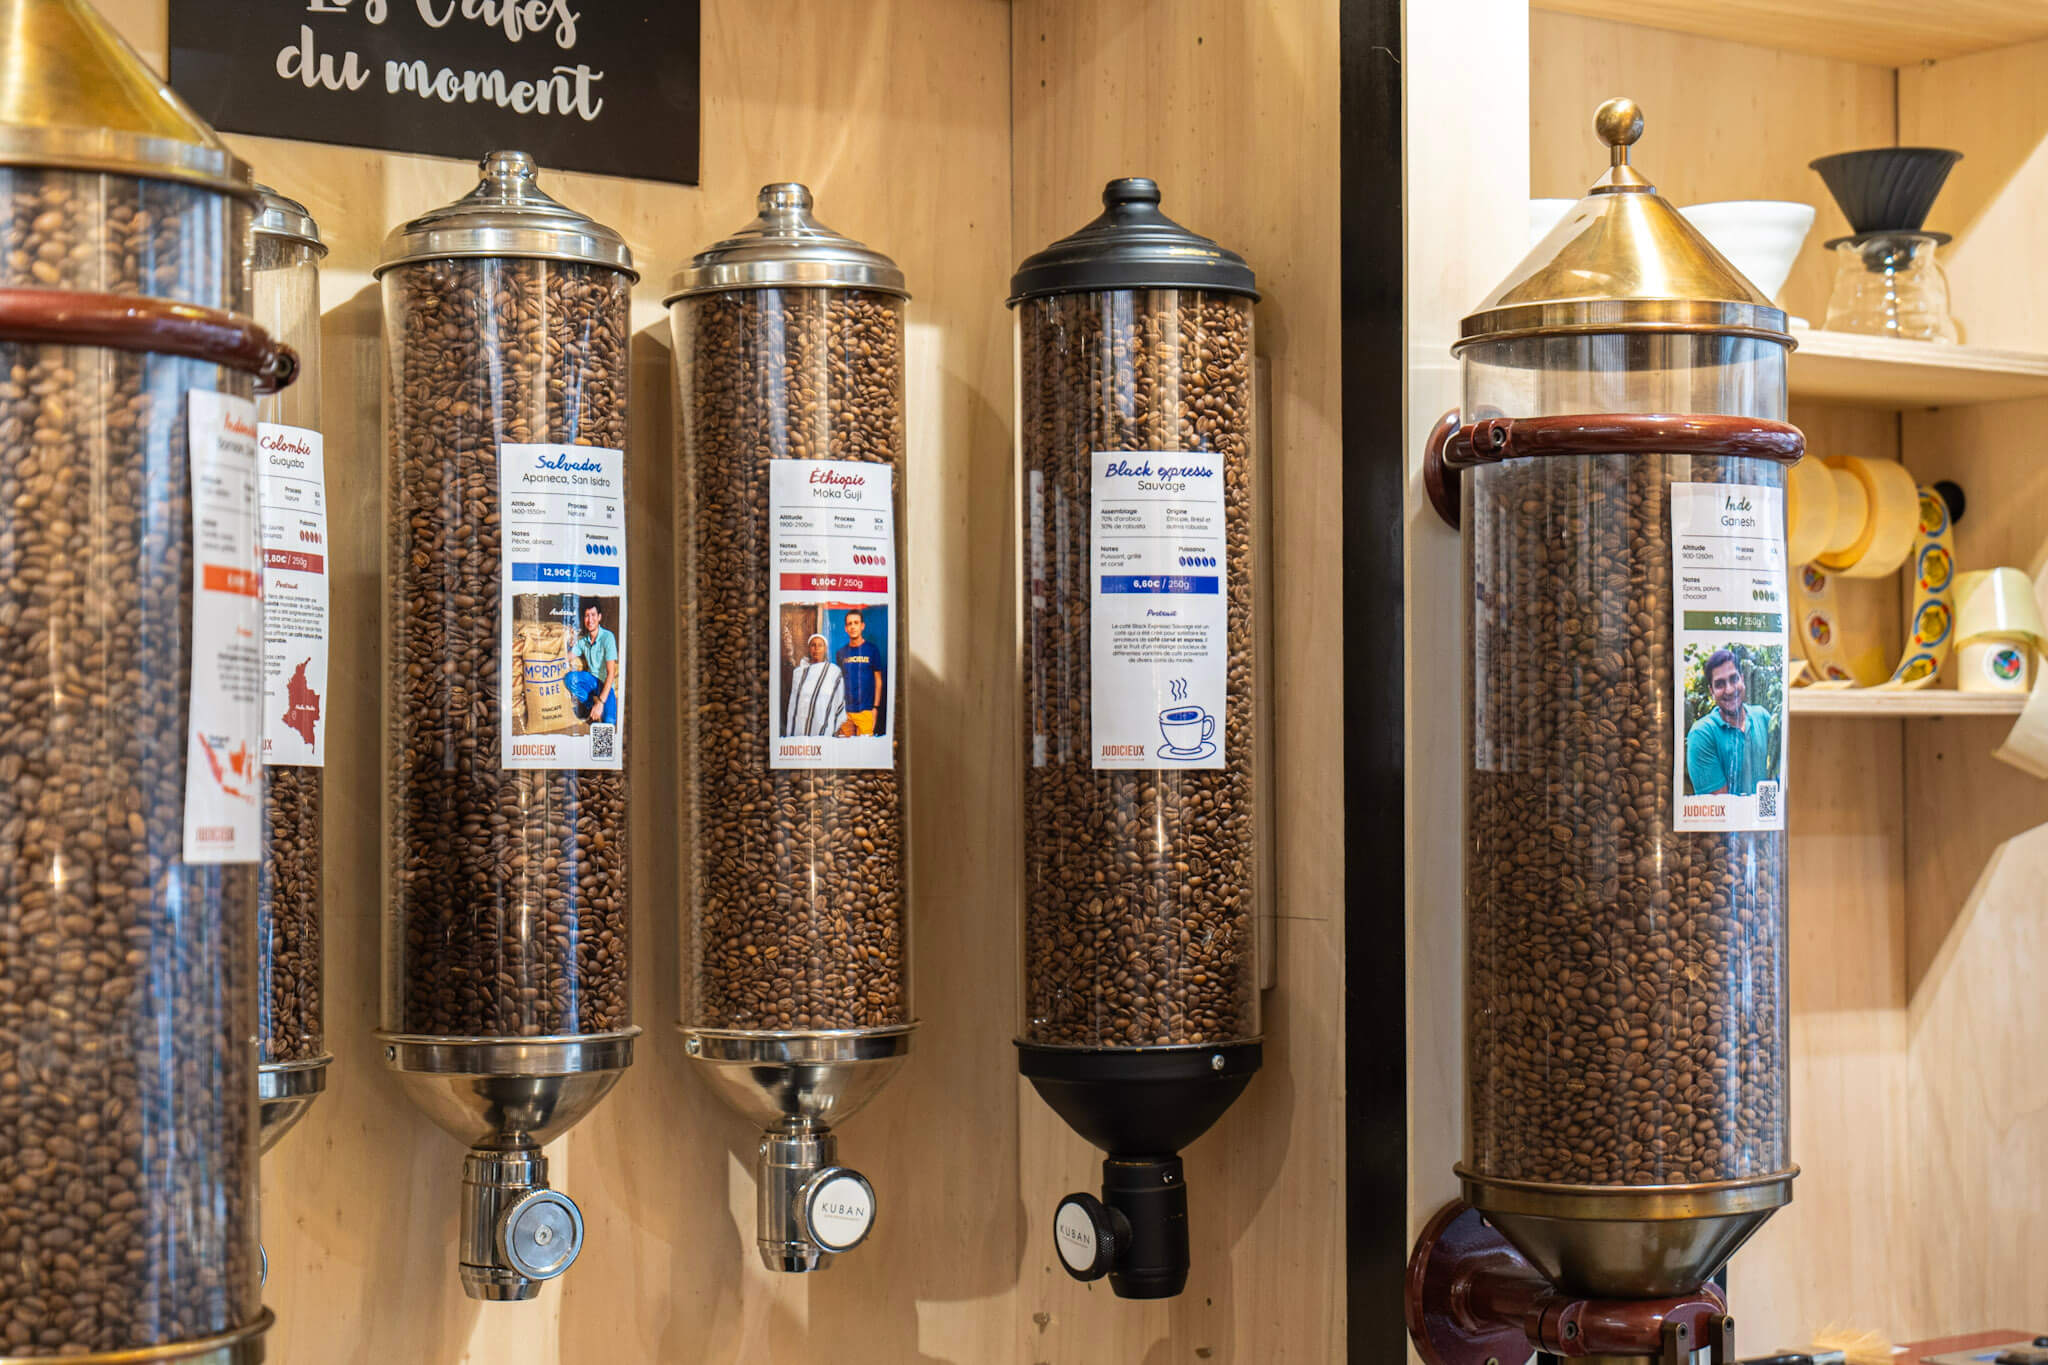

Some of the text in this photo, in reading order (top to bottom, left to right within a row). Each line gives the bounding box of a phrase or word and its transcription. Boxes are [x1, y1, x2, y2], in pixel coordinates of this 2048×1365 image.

[275, 24, 604, 122] du moment
[259, 434, 311, 456] Colombie
[269, 454, 305, 469] Guayaba
[535, 453, 602, 473] Salvador
[1105, 460, 1154, 478] Black
[522, 473, 611, 488] Apaneca, San Isidro
[809, 467, 866, 490] Éthiopie
[1137, 481, 1186, 493] Sauvage
[813, 488, 862, 502] Moka Guji
[1725, 496, 1752, 511] Inde
[1720, 515, 1755, 527] Ganesh
[578, 568, 597, 580] 250g
[843, 578, 863, 590] 250g
[1168, 580, 1190, 591] 250g
[539, 683, 561, 697] CAFÉ
[511, 744, 556, 757] JUDICIEUX
[779, 744, 822, 757] JUDICIEUX
[1101, 745, 1145, 757] JUDICIEUX
[1683, 805, 1726, 817] JUDICIEUX
[821, 1201, 864, 1217] KUBAN
[1060, 1224, 1090, 1245] KUBAN
